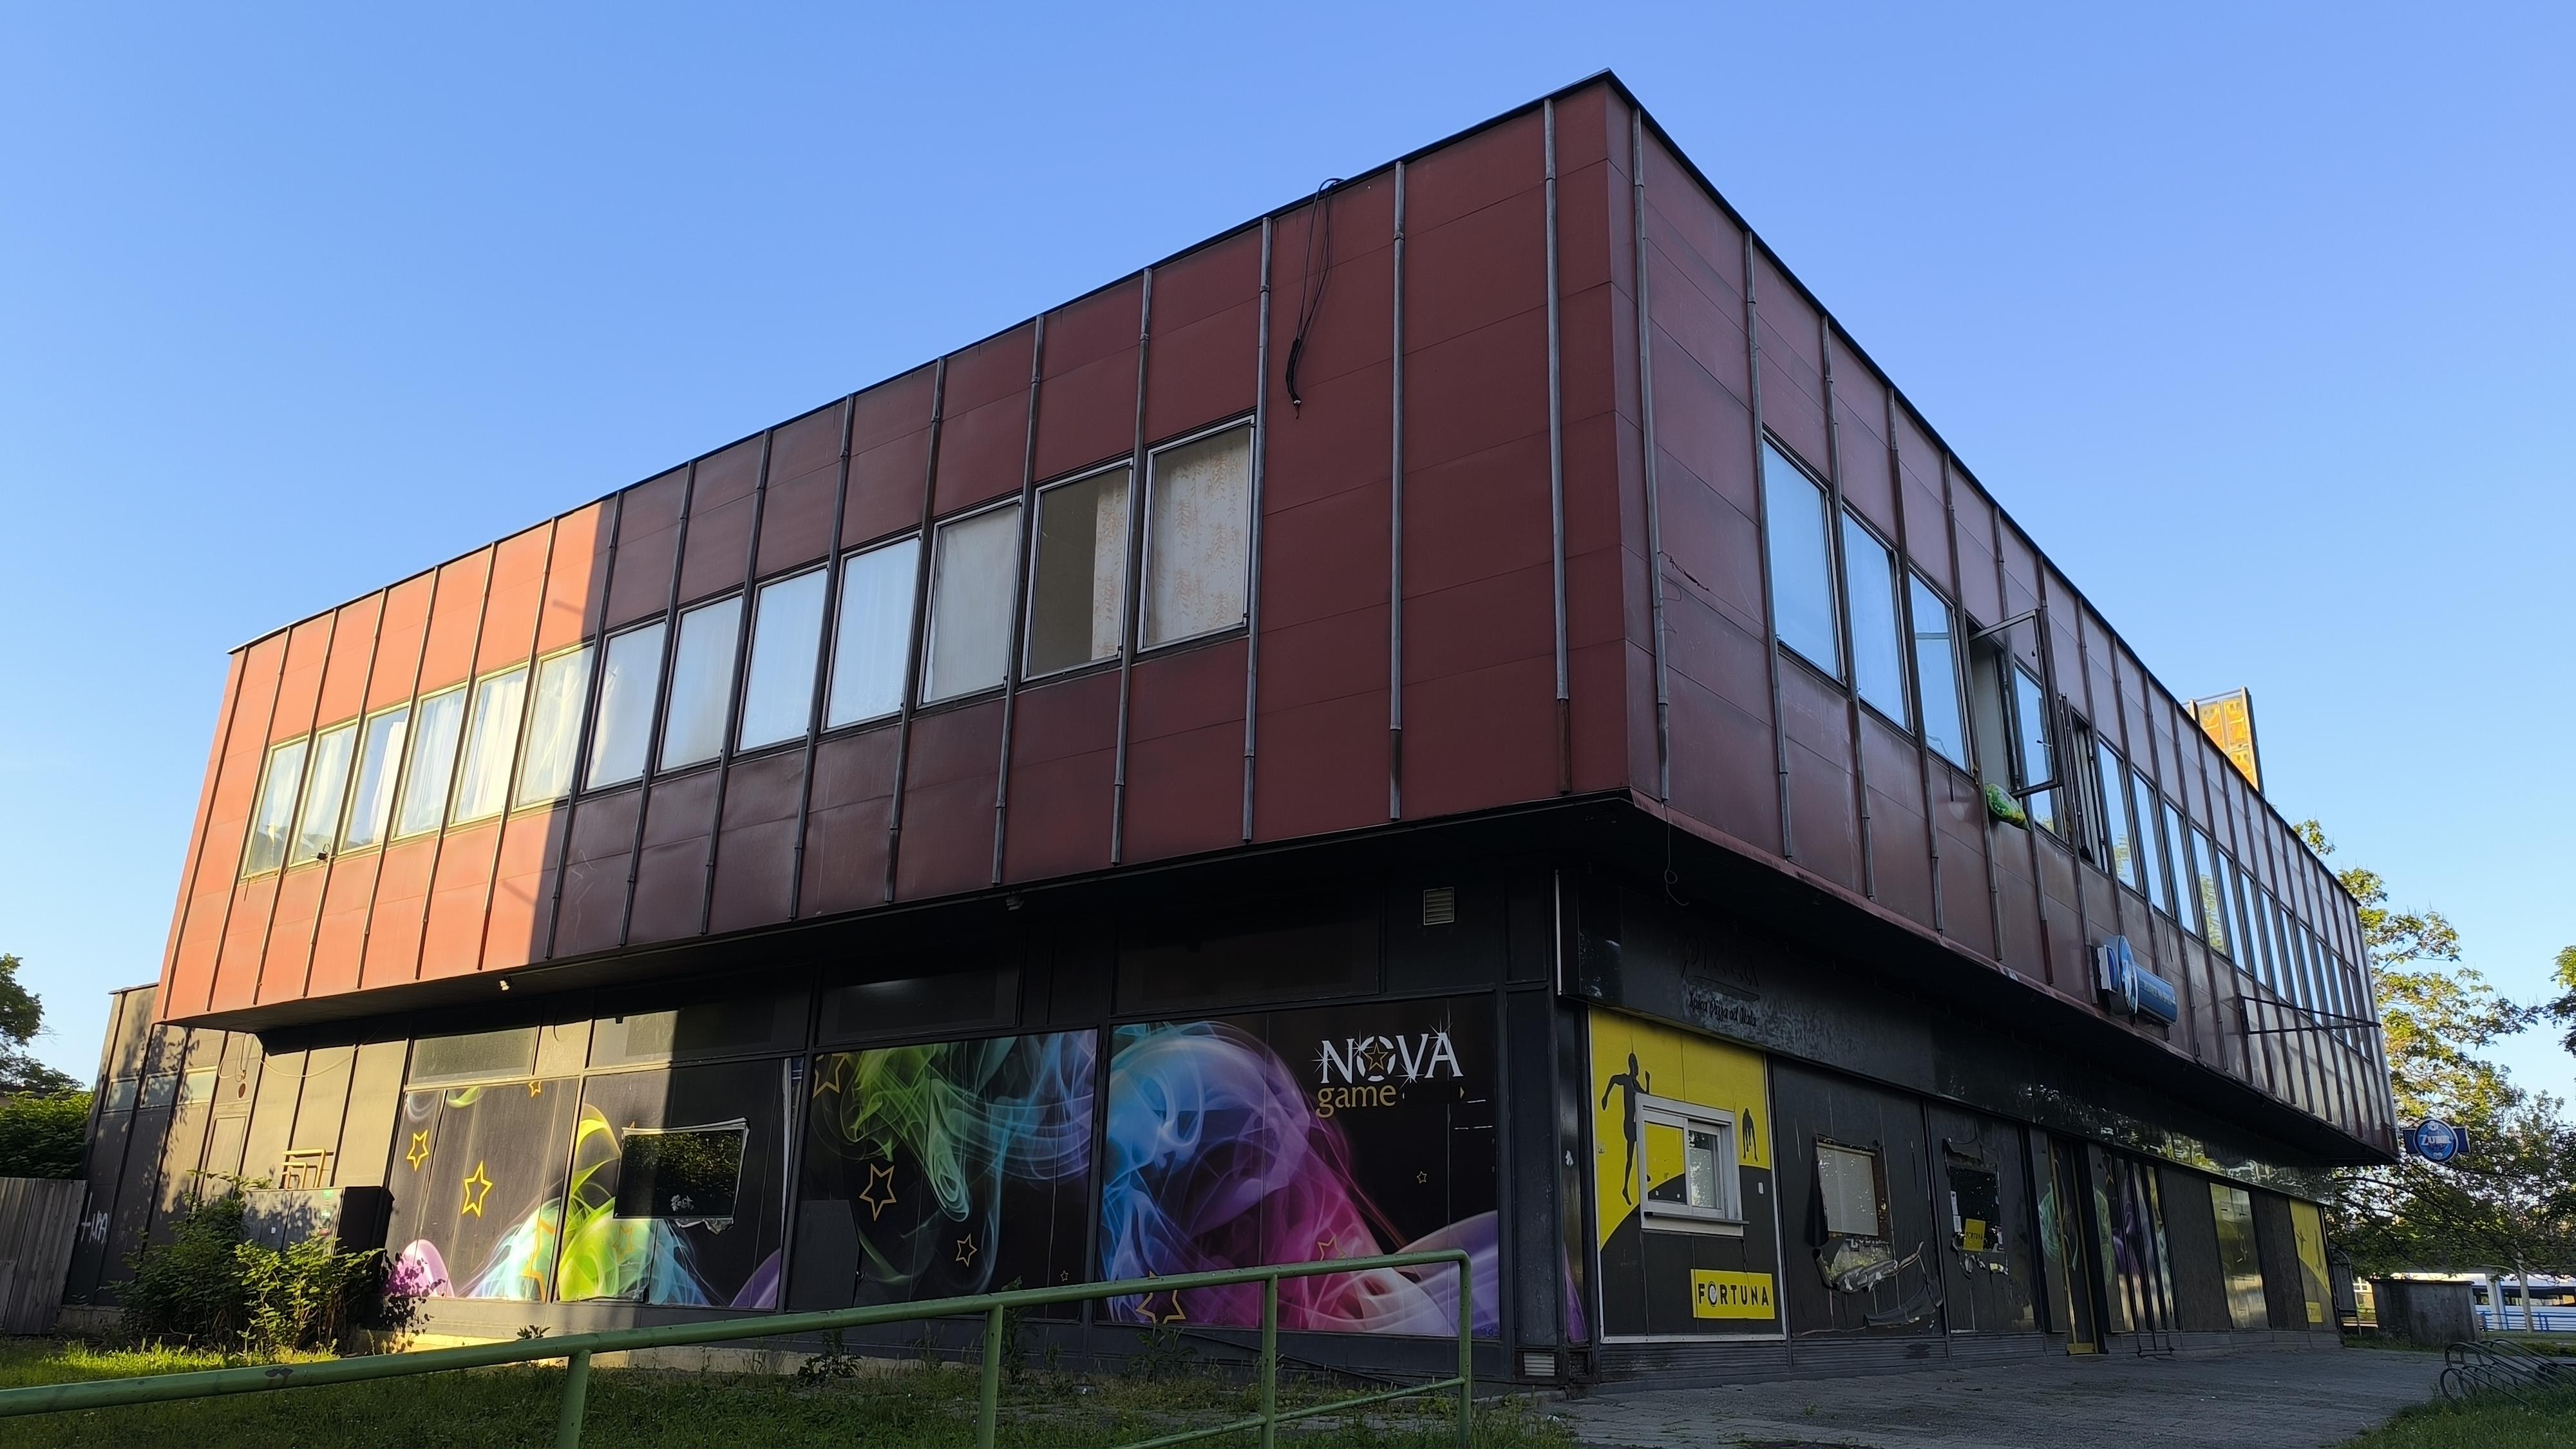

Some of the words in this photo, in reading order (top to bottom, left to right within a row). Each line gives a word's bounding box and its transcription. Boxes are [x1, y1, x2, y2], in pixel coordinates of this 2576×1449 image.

[1320, 1032, 1464, 1084] NOVA
[1315, 1084, 1397, 1119] game
[1697, 1281, 1770, 1307] FORTUNA
